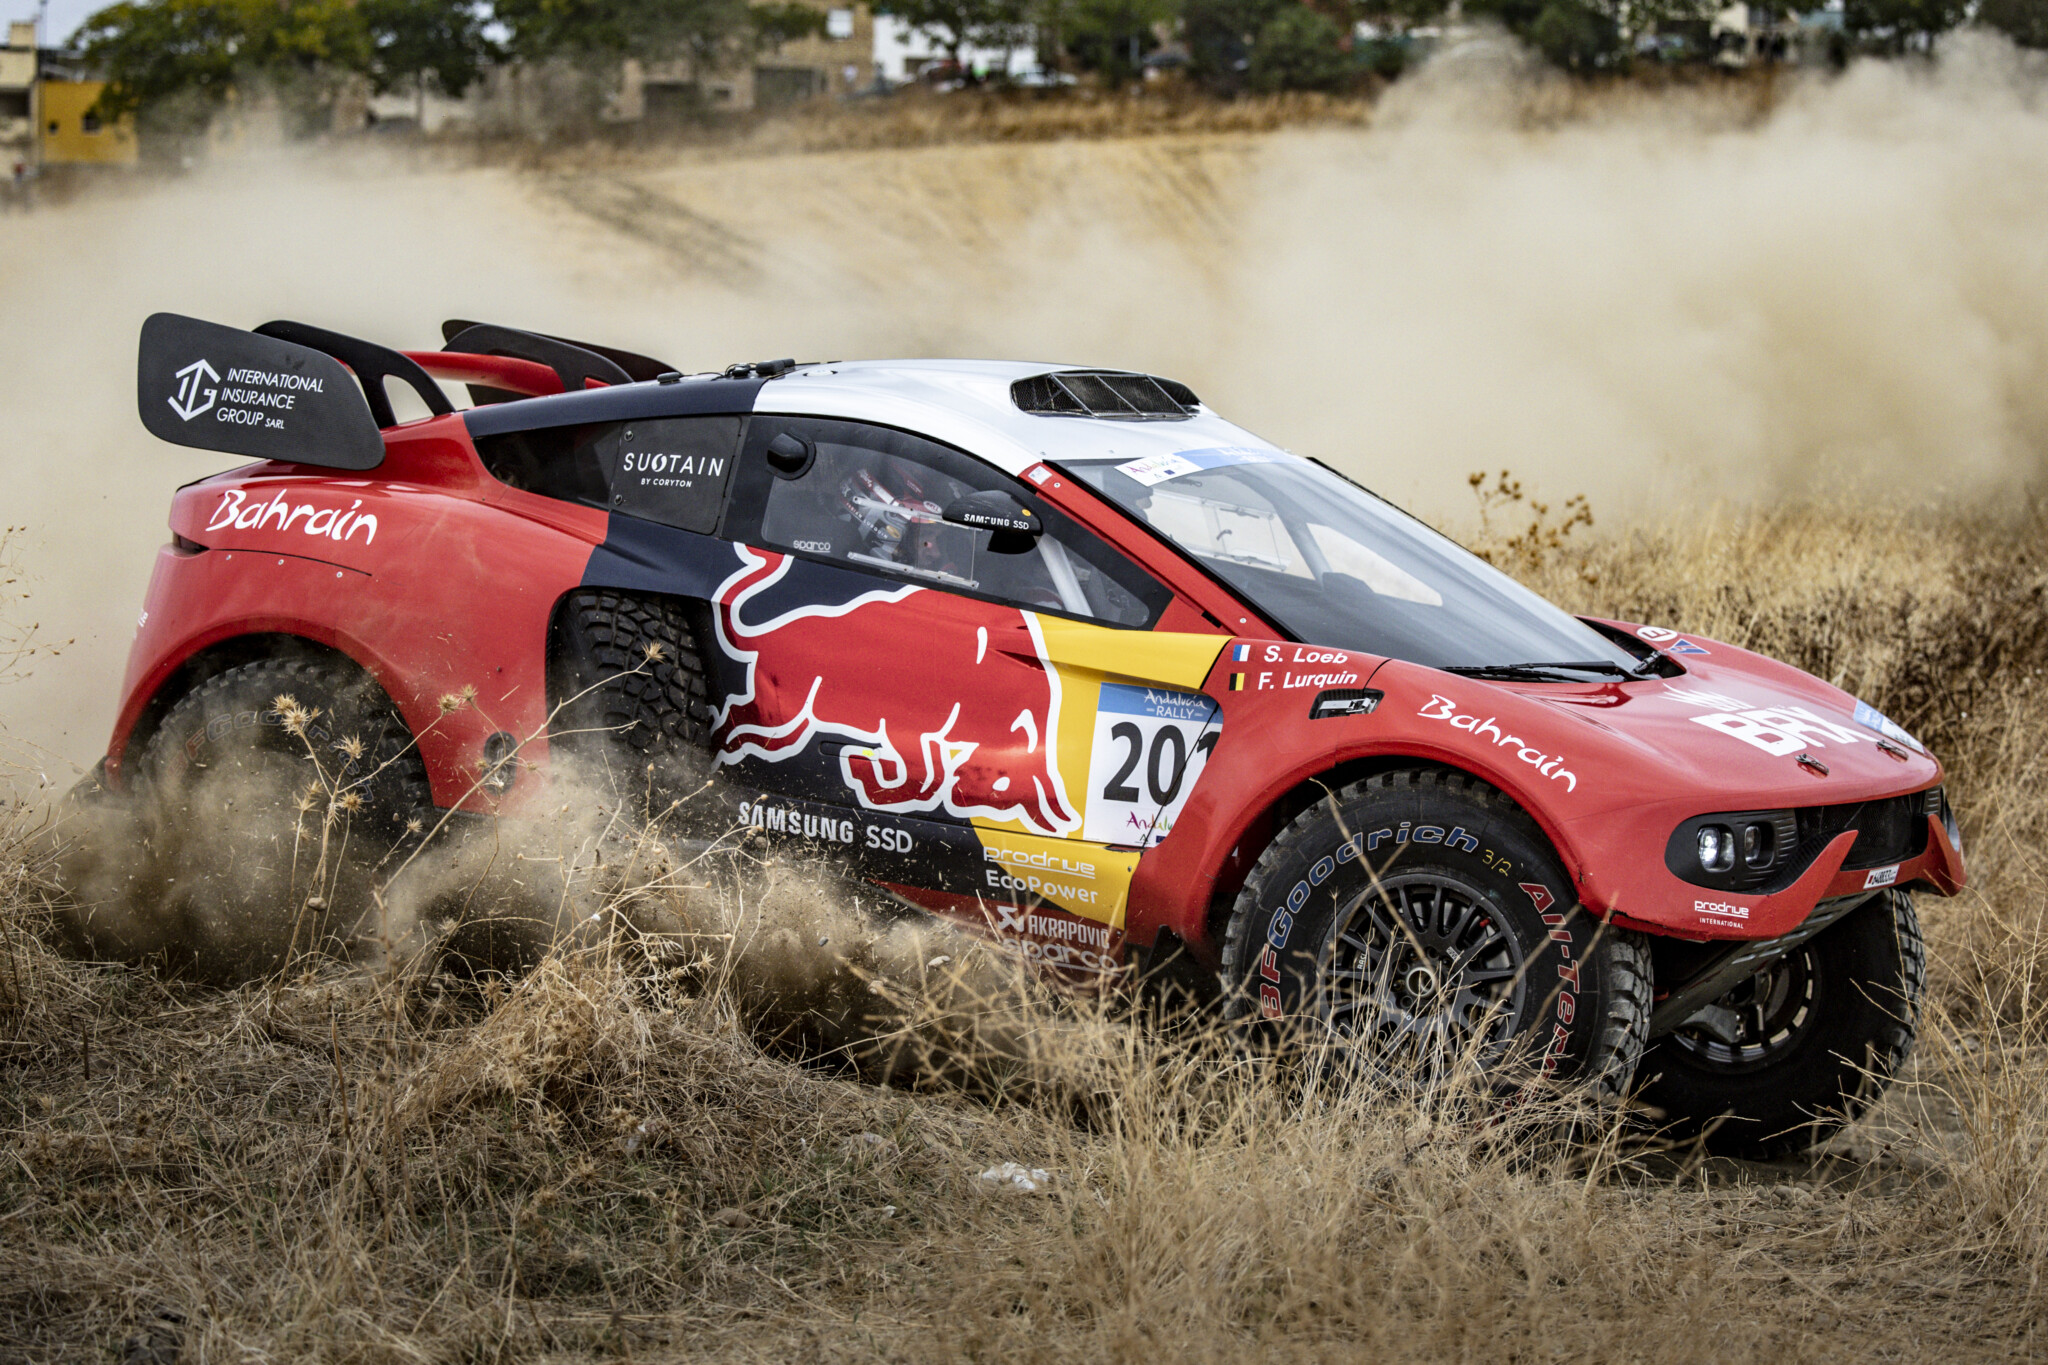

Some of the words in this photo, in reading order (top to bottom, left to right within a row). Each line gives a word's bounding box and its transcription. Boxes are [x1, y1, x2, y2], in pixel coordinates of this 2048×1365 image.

[227, 367, 324, 393] INTERNATIONAL
[221, 387, 295, 410] INSURANCE
[216, 407, 264, 426] GROUP
[265, 417, 285, 430] SARL
[640, 477, 651, 486] BY
[653, 478, 692, 488] CORYTON
[205, 488, 378, 546] Bahrain
[963, 513, 1010, 527] SAMSUNG
[1013, 520, 1030, 530] SSD
[793, 540, 831, 553] sparco
[1264, 645, 1283, 663] S.
[1293, 648, 1348, 664] Loeb
[1258, 672, 1274, 690] F.
[1283, 671, 1358, 688] Lurquin
[1156, 705, 1194, 720] RALLY
[1417, 694, 1577, 793] Bahrain
[738, 801, 854, 844] SAMSUNG
[866, 825, 913, 853] SSD
[983, 847, 1096, 879] prodrive
[986, 869, 1098, 904] EcoPower
[1694, 900, 1749, 919] prodrive
[1260, 822, 1479, 1021] BFGoodrich
[1699, 917, 1744, 929] INTERNATIONAL
[1001, 938, 1122, 978] sparco
